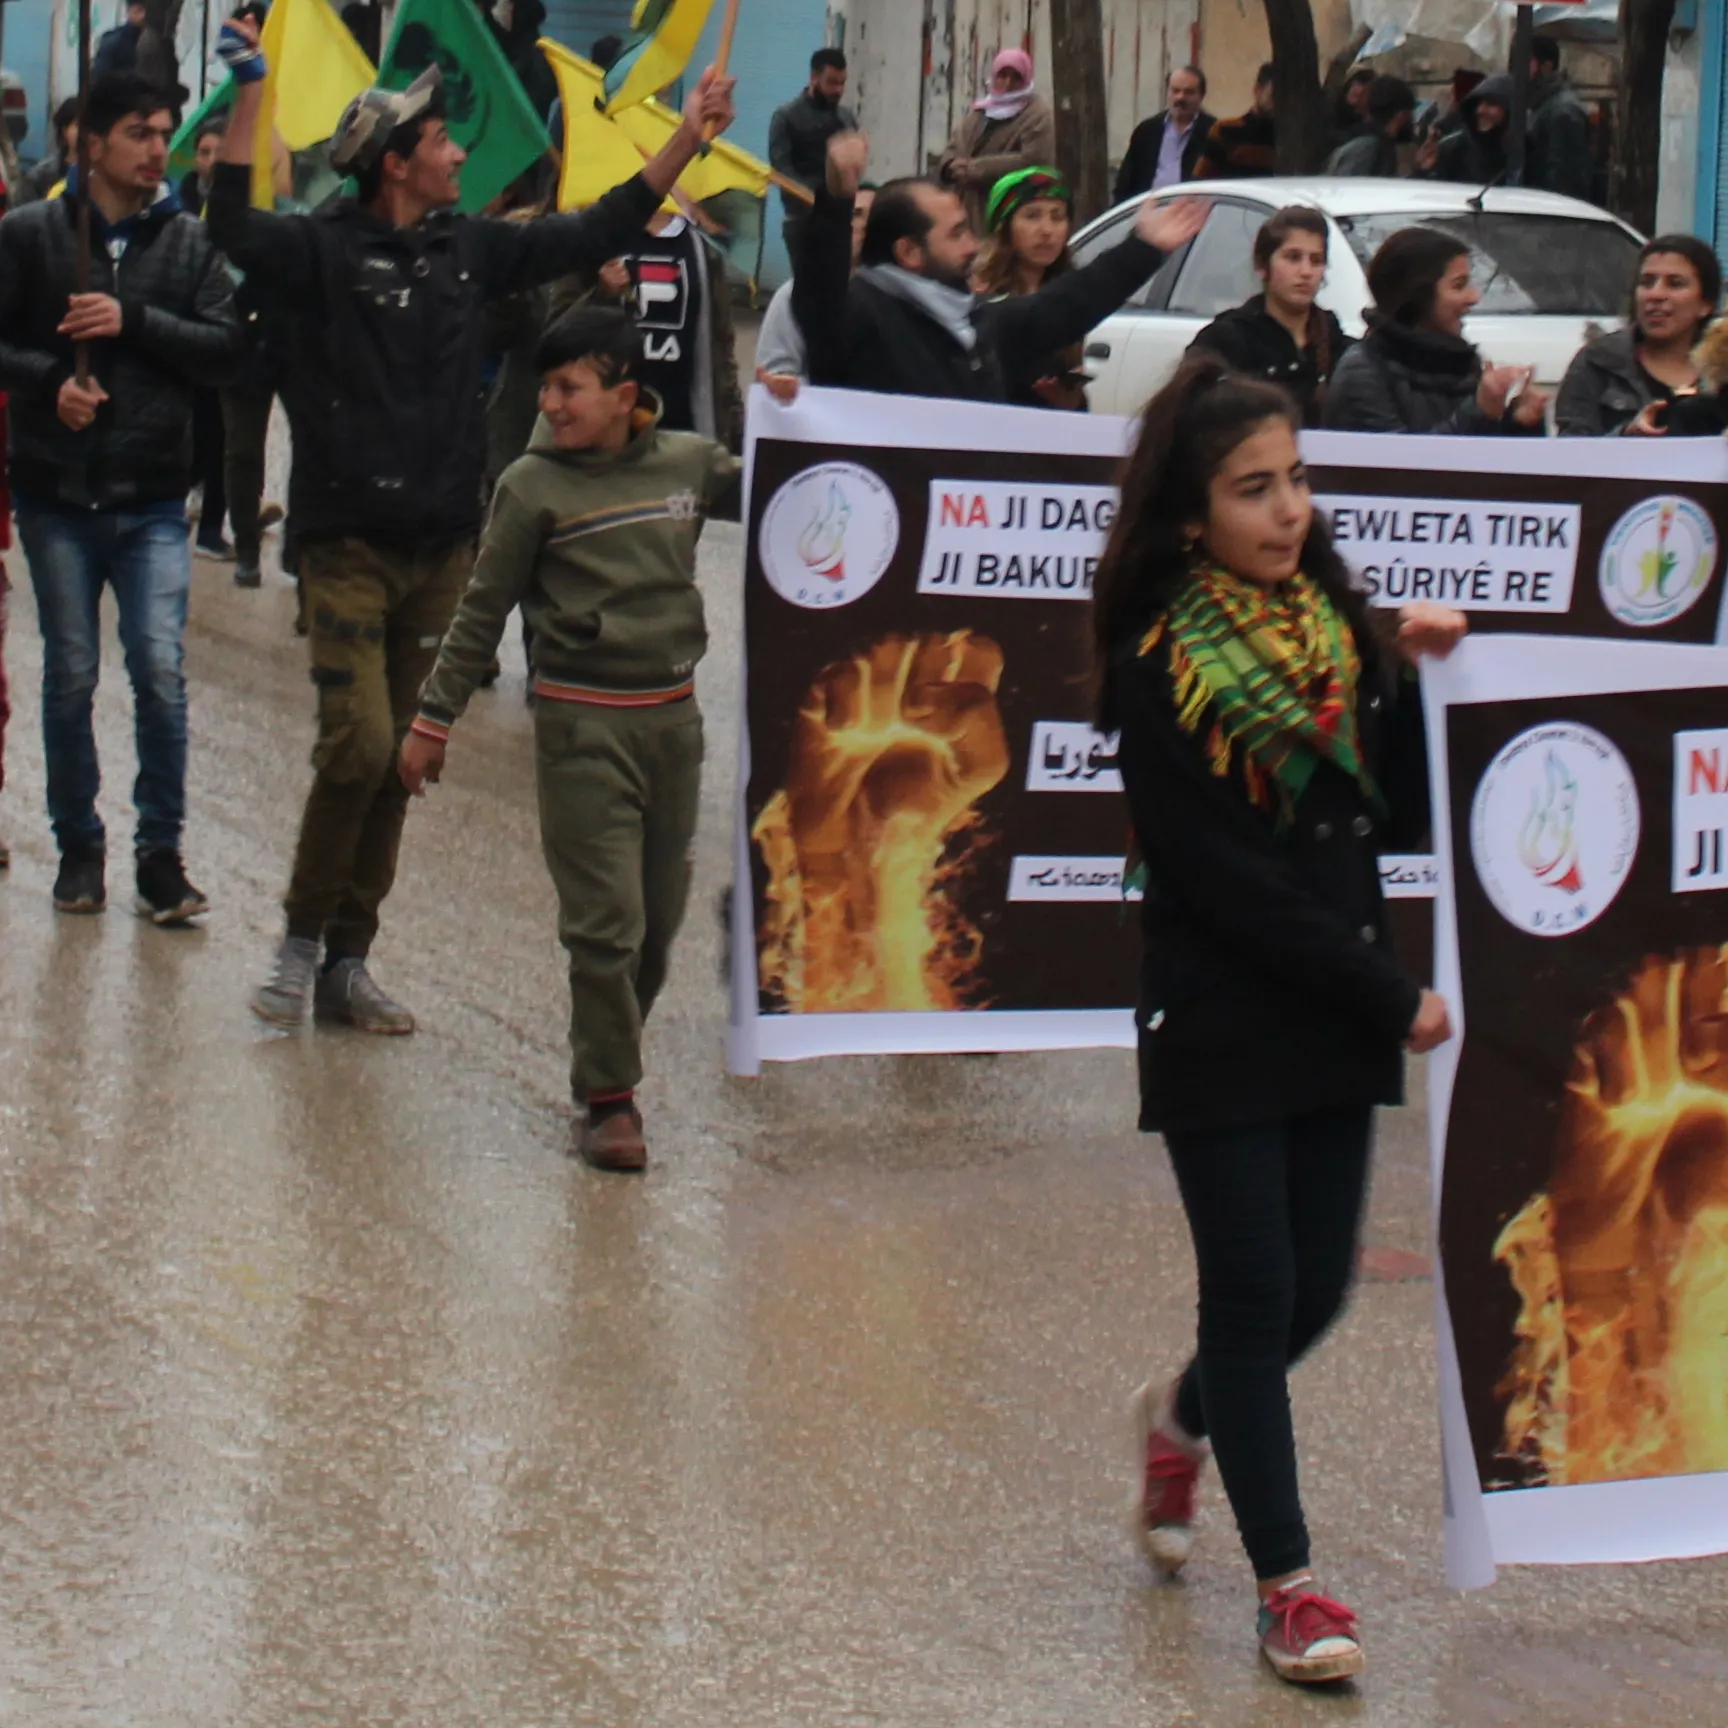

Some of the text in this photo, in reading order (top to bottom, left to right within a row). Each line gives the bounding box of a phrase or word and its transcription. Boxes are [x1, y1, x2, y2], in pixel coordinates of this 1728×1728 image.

[940, 493, 1118, 533] NA JI DAG
[1332, 508, 1473, 545] EWLETA
[1487, 513, 1569, 549] TIRK
[930, 551, 963, 585] JI
[1362, 557, 1554, 603] SÛRIYÊ RE
[1687, 827, 1723, 878] JI
